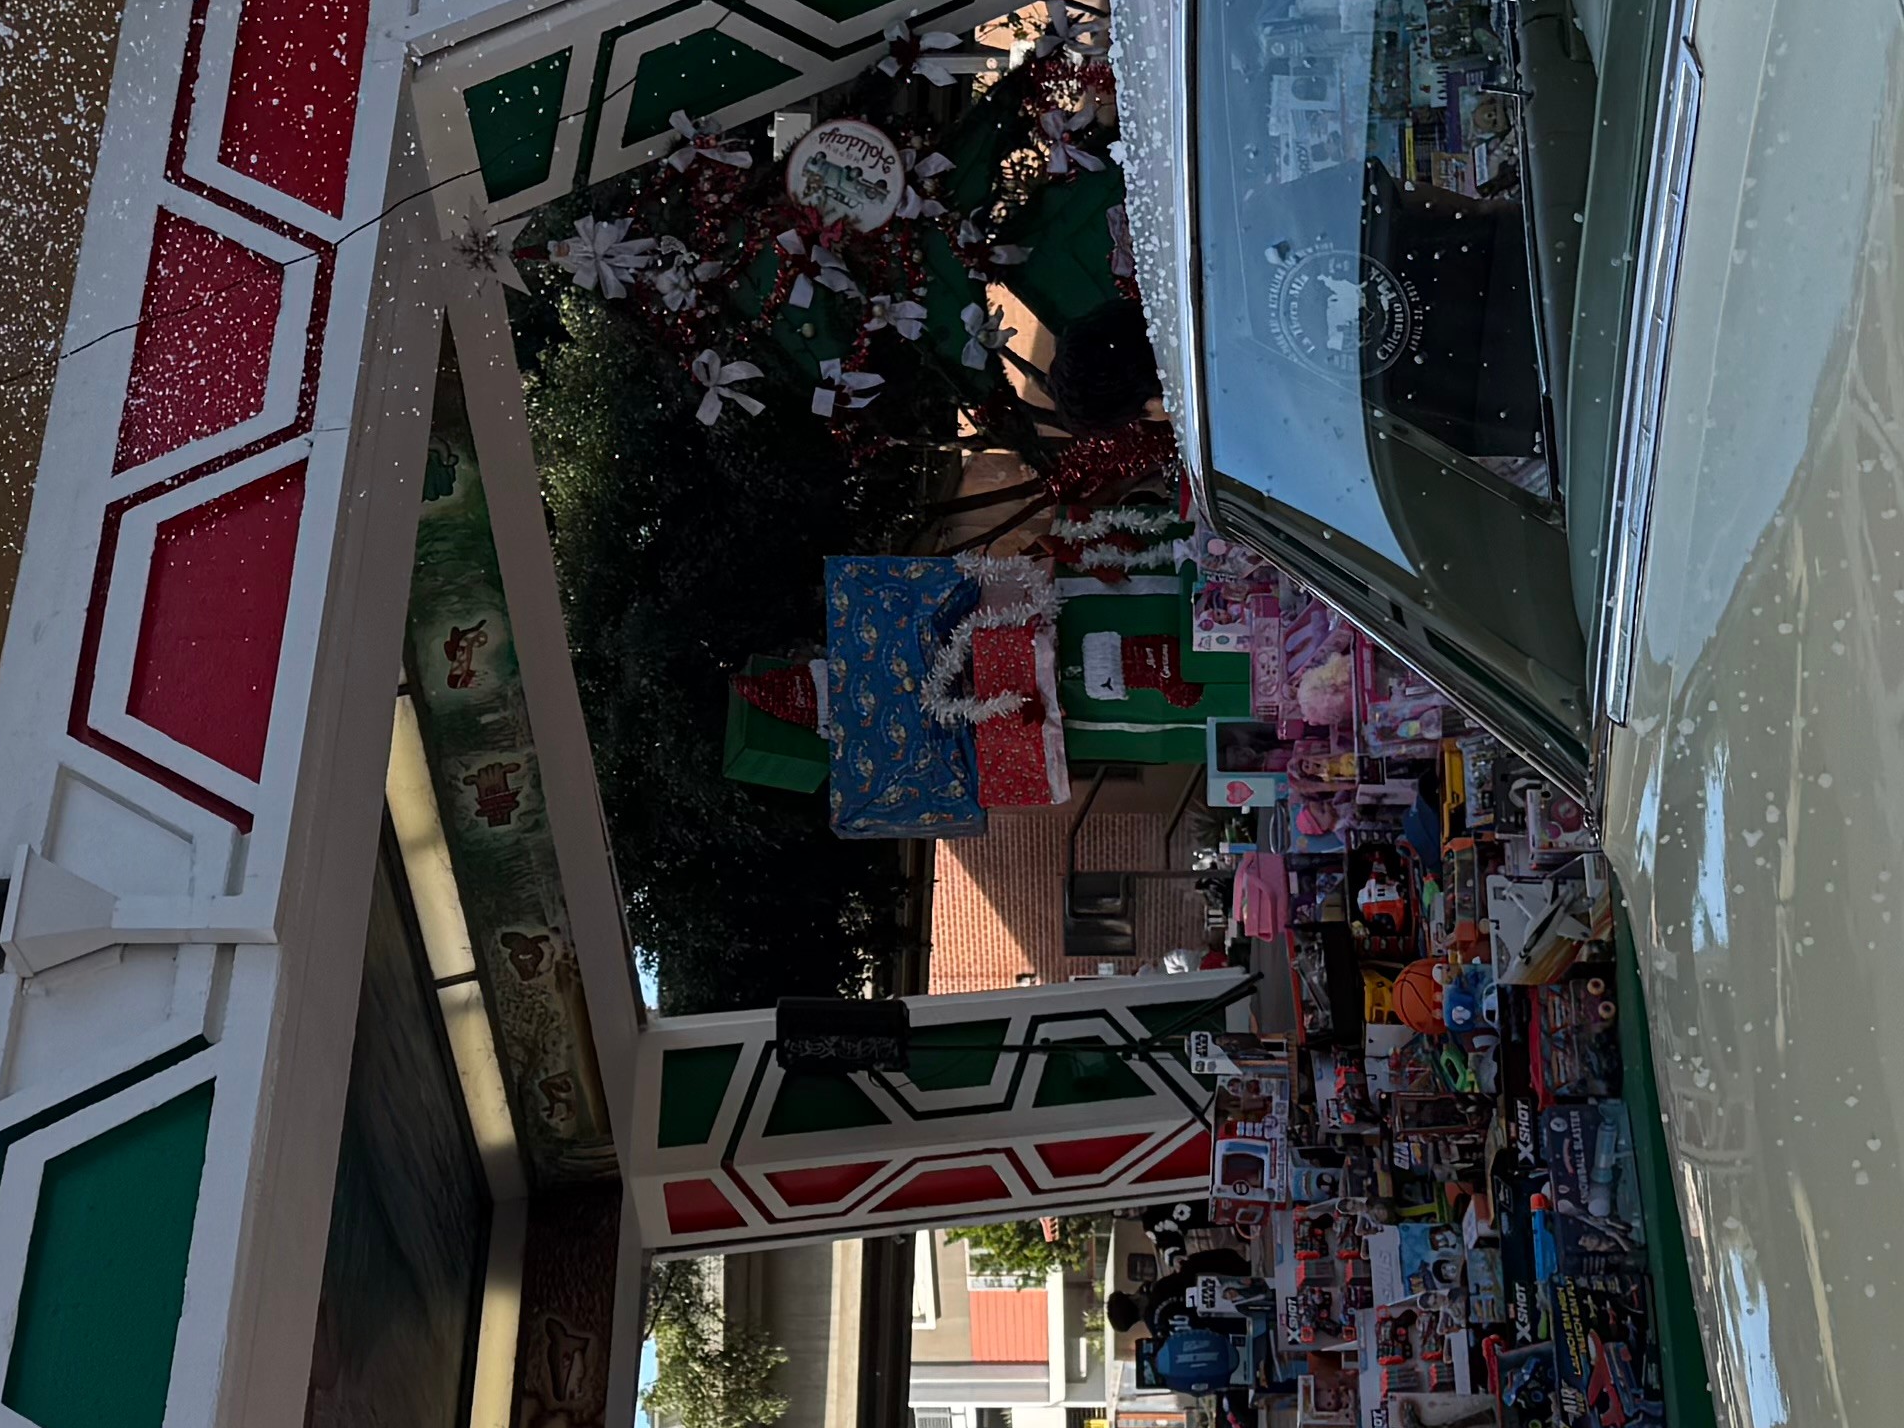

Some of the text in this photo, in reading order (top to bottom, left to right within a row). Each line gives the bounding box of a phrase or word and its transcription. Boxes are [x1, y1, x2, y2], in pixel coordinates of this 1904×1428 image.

[817, 126, 896, 174] Holidays
[1569, 1110, 1590, 1204] SNOWBALL BLASTER
